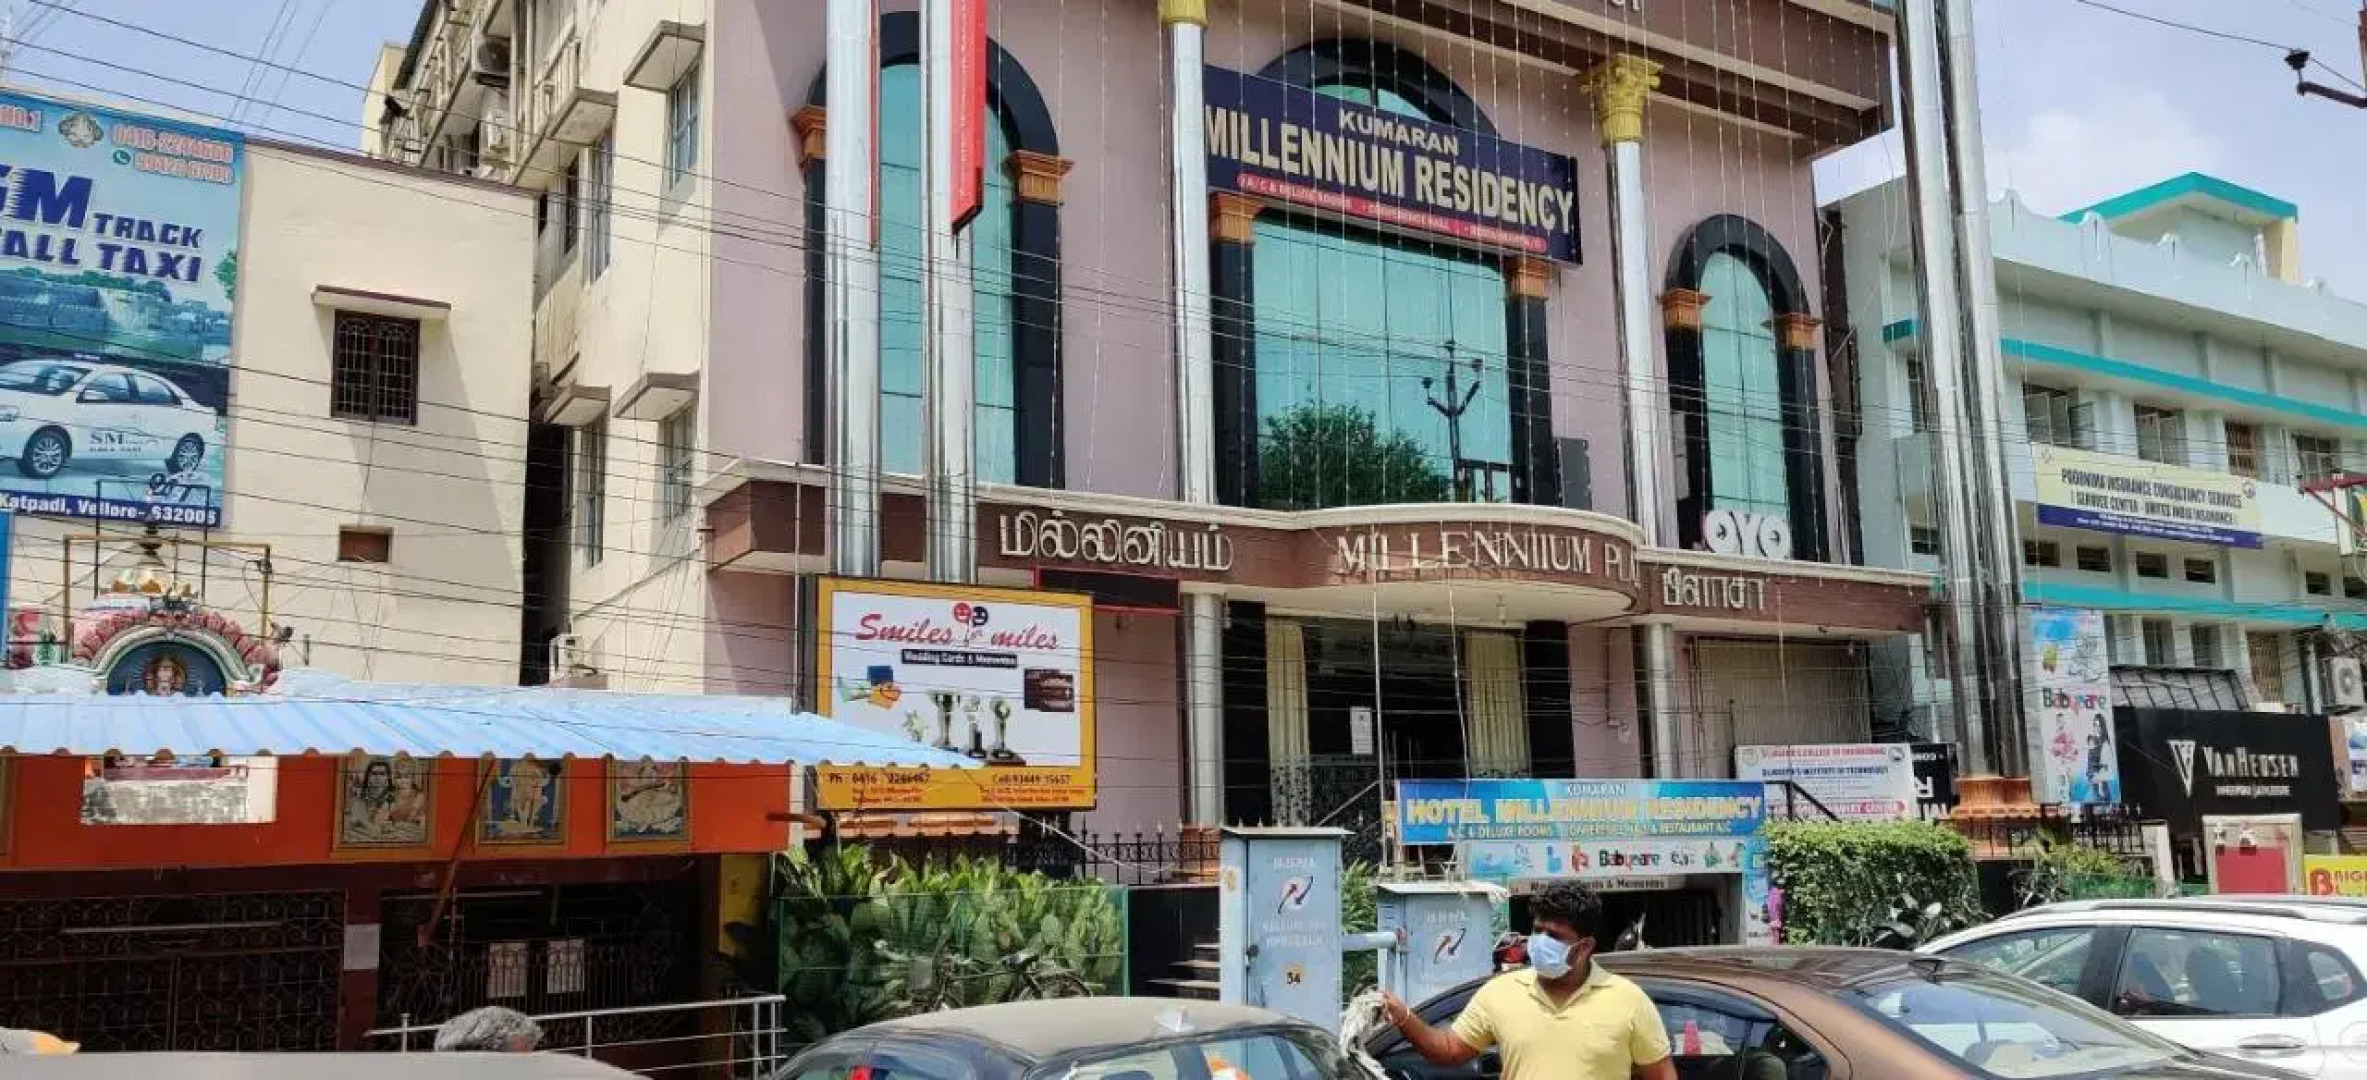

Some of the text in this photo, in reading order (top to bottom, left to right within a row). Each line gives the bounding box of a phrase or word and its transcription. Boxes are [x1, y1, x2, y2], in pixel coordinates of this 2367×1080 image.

[1338, 108, 1460, 156] KUMARAN
[1204, 104, 1574, 235] MILLENNIUM RESIDENCY
[94, 212, 203, 248] TRACK
[0, 228, 202, 282] ALL TAXI
[999, 510, 1234, 571] மில்லினியம்
[1703, 510, 1791, 560] OYO
[855, 613, 954, 647] Smiles
[991, 623, 1060, 650] miles
[1406, 799, 1489, 823] HOTEL
[1495, 799, 1638, 822] MILLENNIUM
[1645, 796, 1763, 820] RESIDENCY
[1567, 783, 1626, 797] KUMARAN
[1599, 848, 1660, 873] Babycare
